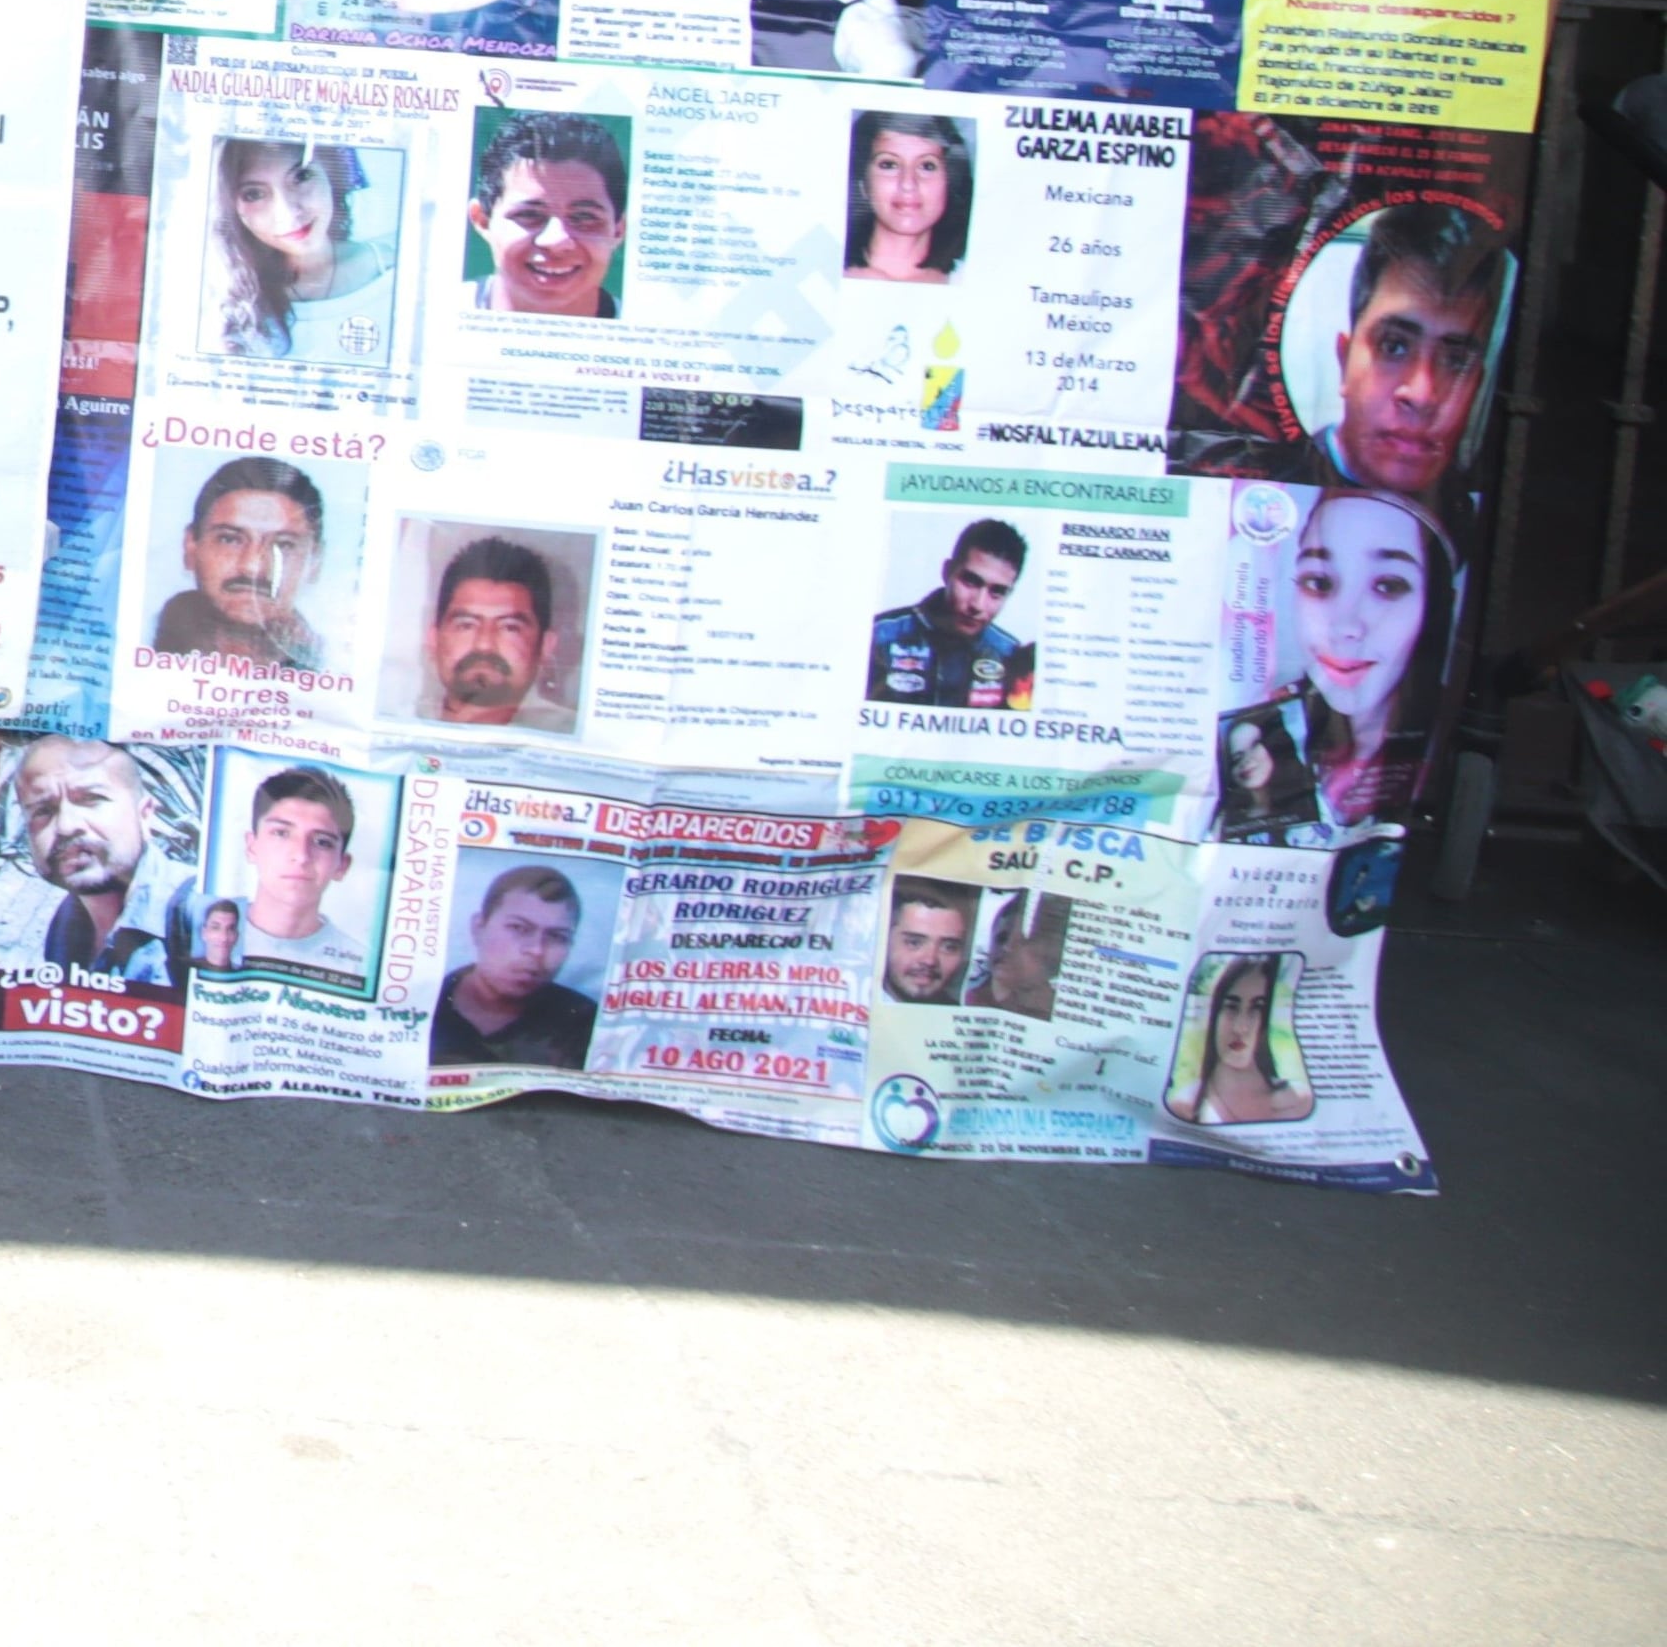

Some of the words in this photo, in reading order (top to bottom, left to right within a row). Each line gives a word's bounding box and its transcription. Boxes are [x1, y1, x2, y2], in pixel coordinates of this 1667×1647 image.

[291, 23, 376, 45] DARIANA
[385, 30, 454, 51] OCHOA
[463, 36, 557, 58] MENDOZA
[1004, 105, 1098, 136] ZULEMA
[1104, 111, 1192, 141] ANABEL
[1017, 136, 1091, 164] GARZA
[1098, 143, 1176, 169] ESPINO
[1045, 184, 1135, 208] Mexicana
[1048, 236, 1074, 253] 26
[1081, 239, 1122, 258] años
[1029, 285, 1134, 311] Tamaulipas
[1046, 312, 1113, 334] México
[1056, 376, 1099, 393] 2014
[141, 415, 278, 453] ¿Donde
[291, 431, 387, 462] está?
[901, 474, 1003, 493] ¡AYUDANOS
[1008, 481, 1019, 494] A
[134, 647, 219, 679] David
[227, 653, 354, 693] Malagón
[192, 679, 290, 705] Torres
[858, 706, 891, 731] SU
[898, 709, 992, 736] FAMILIA
[998, 716, 1027, 738] LO
[1034, 718, 1124, 746] ESPERA
[605, 807, 812, 846] DESAPARECIDOS
[626, 873, 734, 895] GERARDO
[69, 961, 126, 993] has
[19, 989, 165, 1042] visto?
[647, 1045, 680, 1066] 10
[687, 1050, 744, 1071] AGO
[755, 1053, 827, 1082] 2021
